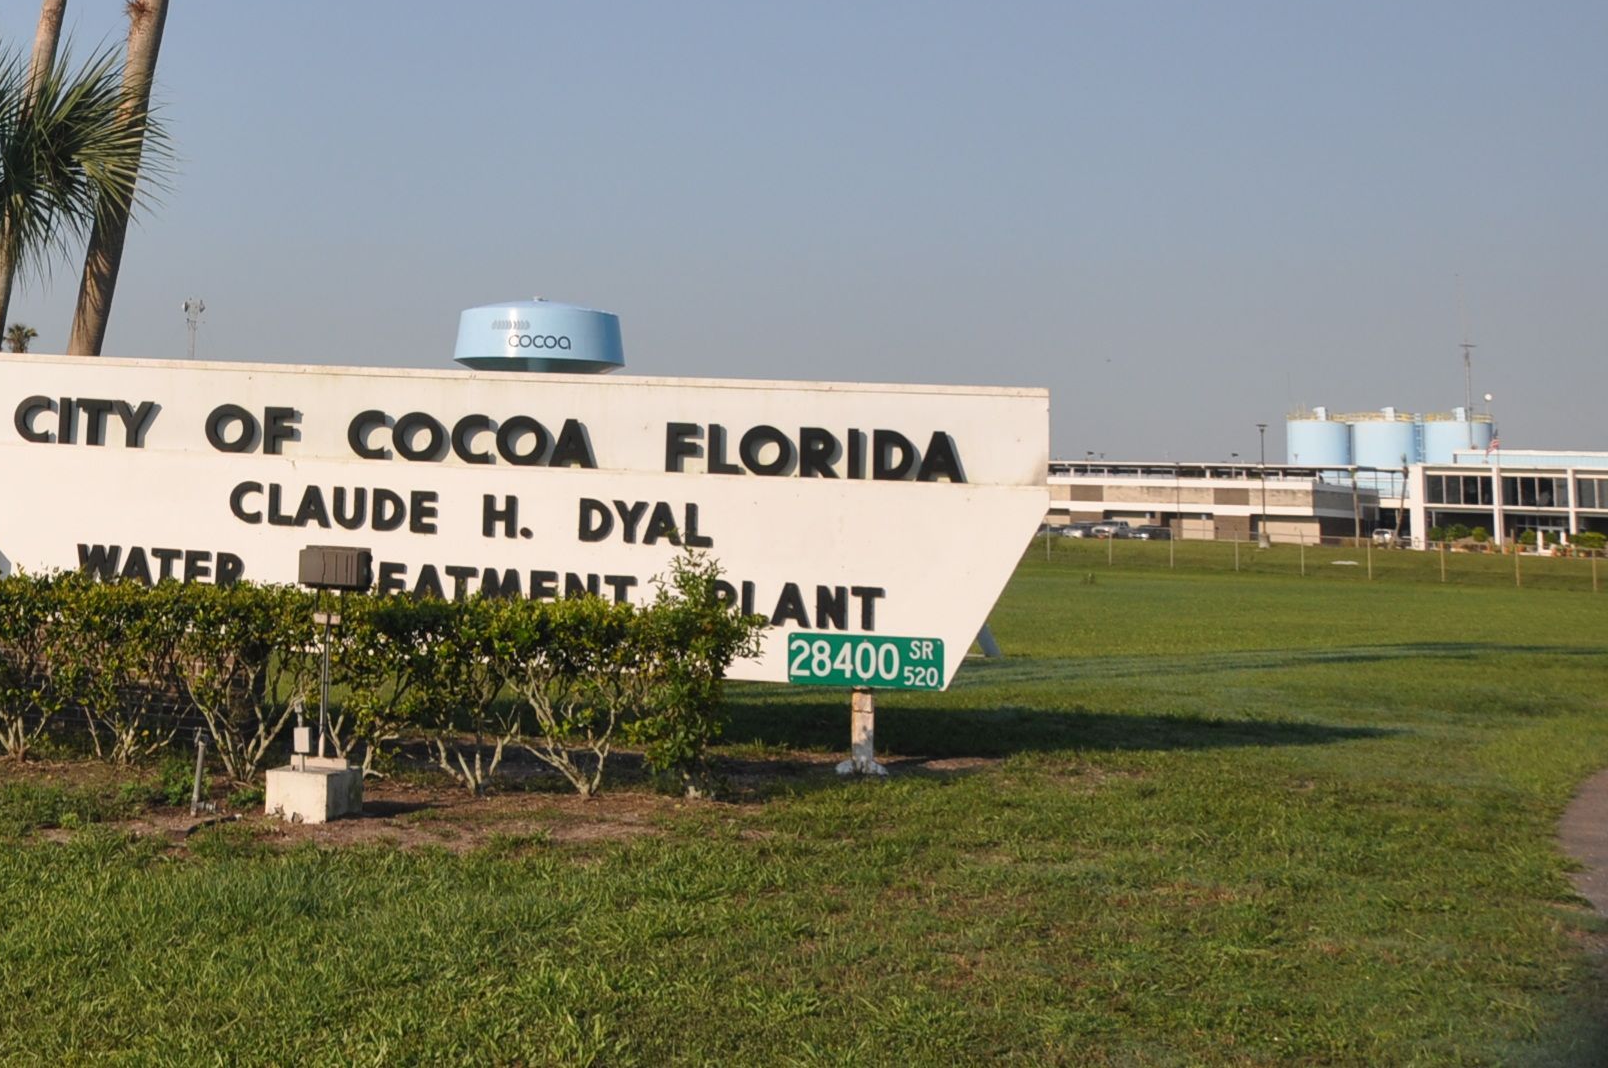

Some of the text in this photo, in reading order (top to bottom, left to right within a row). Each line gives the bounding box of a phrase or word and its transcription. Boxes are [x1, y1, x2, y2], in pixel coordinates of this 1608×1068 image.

[14, 395, 969, 484] CITY OF COCOA FLORIDA
[230, 481, 713, 548] CLAUDE H. DYAL
[77, 543, 244, 588] WATER
[377, 561, 638, 605] EATMENT
[790, 638, 900, 681] 28400
[909, 640, 934, 661] SR
[903, 666, 939, 688] 520
